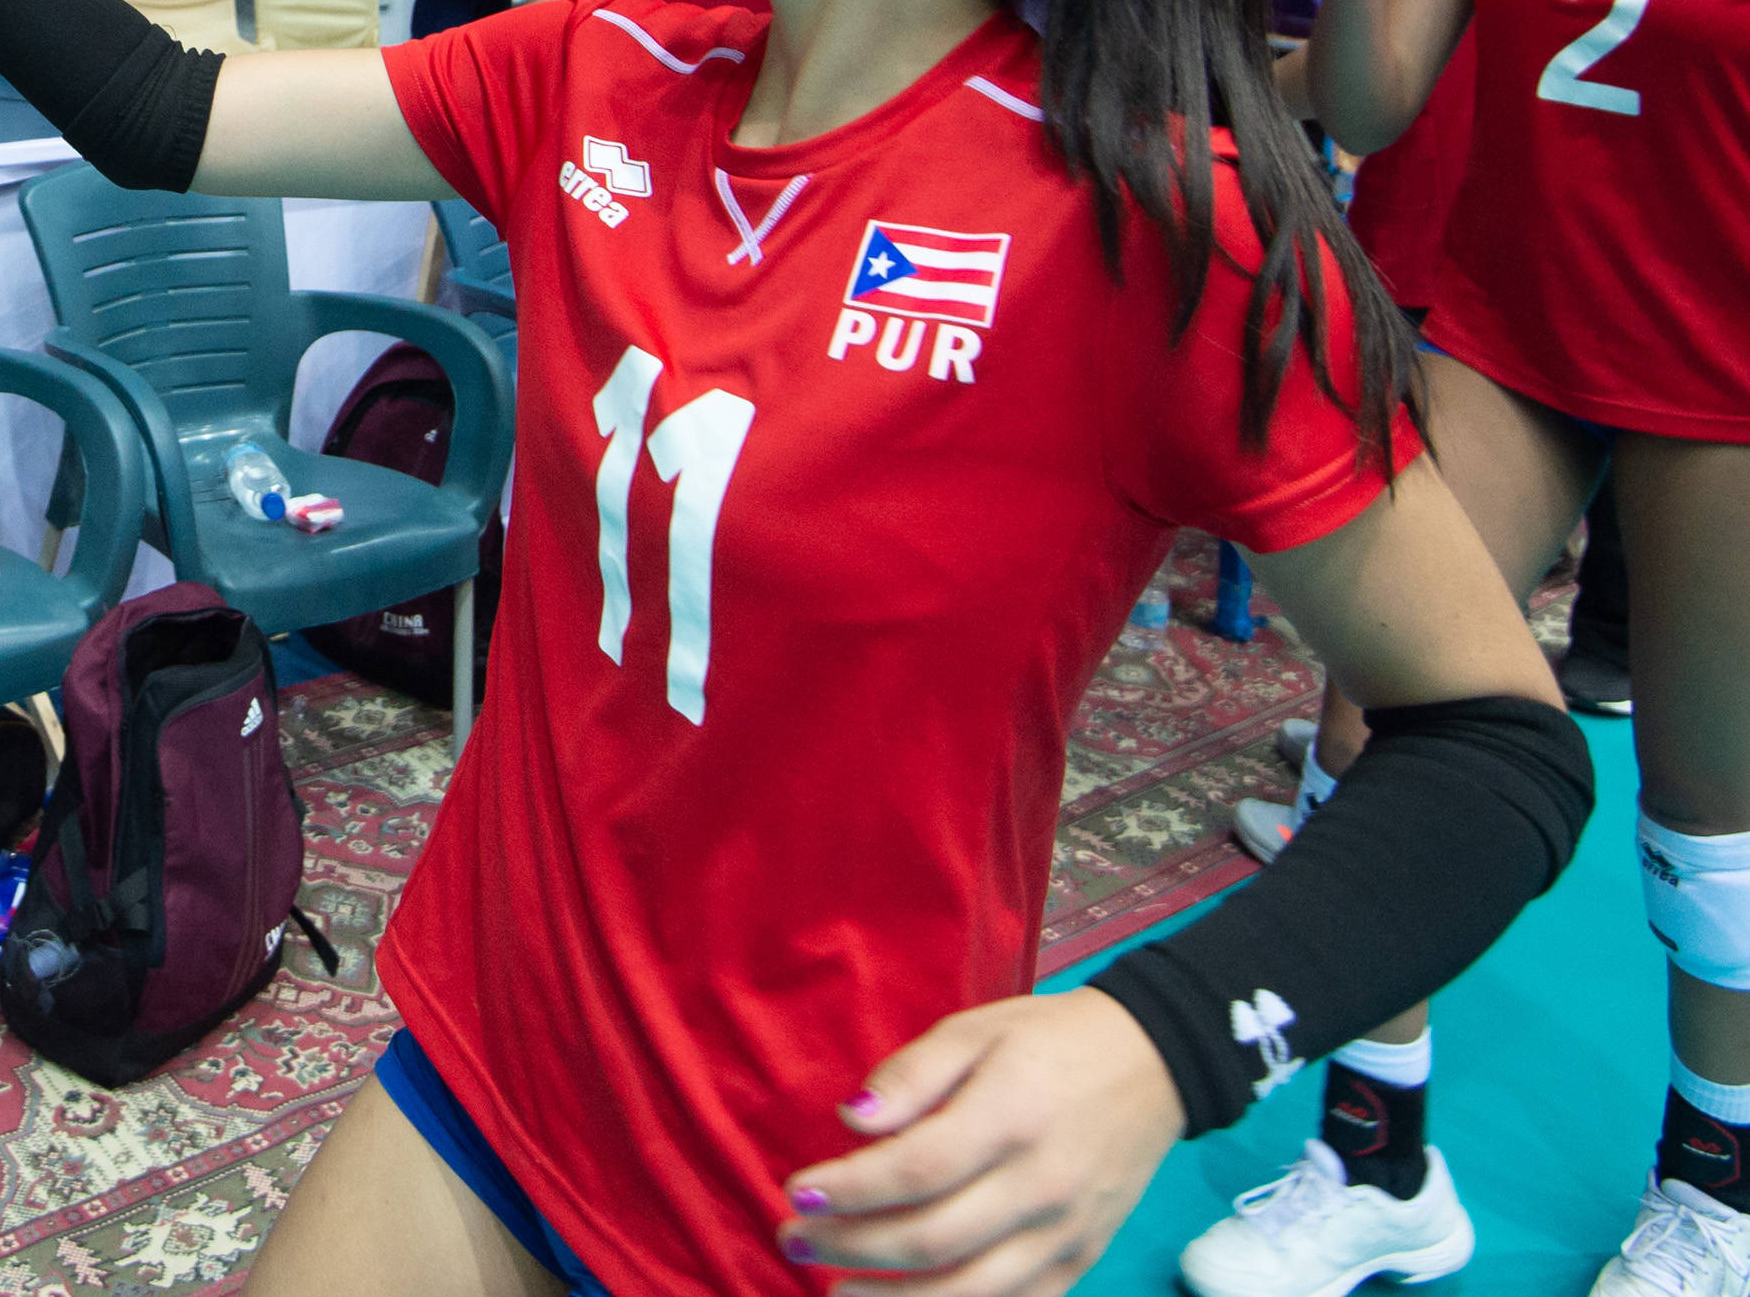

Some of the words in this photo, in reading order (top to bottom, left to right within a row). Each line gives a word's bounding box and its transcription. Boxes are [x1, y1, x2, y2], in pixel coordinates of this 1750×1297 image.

[559, 160, 630, 229] errea
[827, 308, 984, 384] PUR
[592, 344, 756, 727] 11
